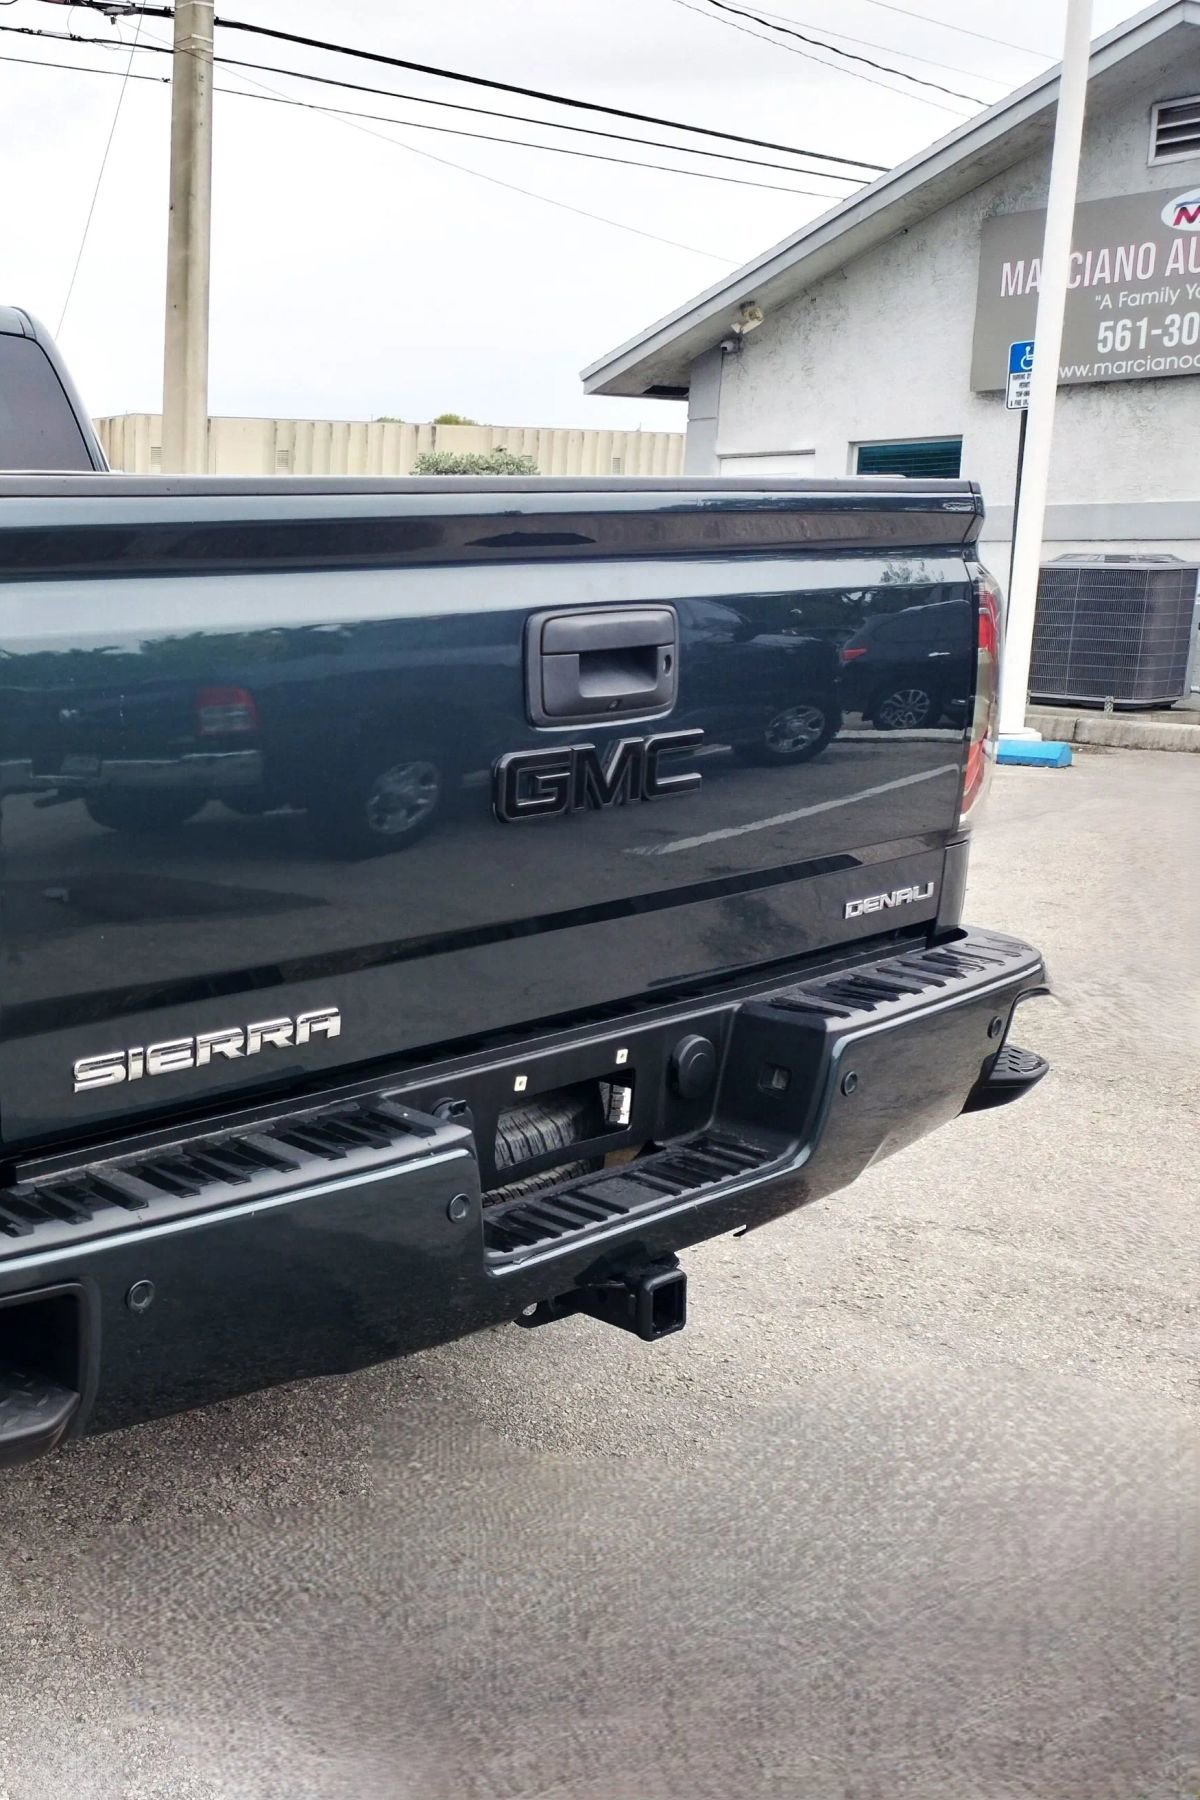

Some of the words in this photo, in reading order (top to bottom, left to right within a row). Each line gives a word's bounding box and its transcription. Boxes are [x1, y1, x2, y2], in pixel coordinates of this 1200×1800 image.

[1000, 241, 1156, 297] MACIANO
[1118, 286, 1180, 308] Family
[1097, 311, 1200, 353] 561-30
[1059, 353, 1200, 379] ww.marciano
[492, 728, 705, 823] GMC
[843, 881, 935, 919] DENALI
[73, 1007, 341, 1093] SIERRA
